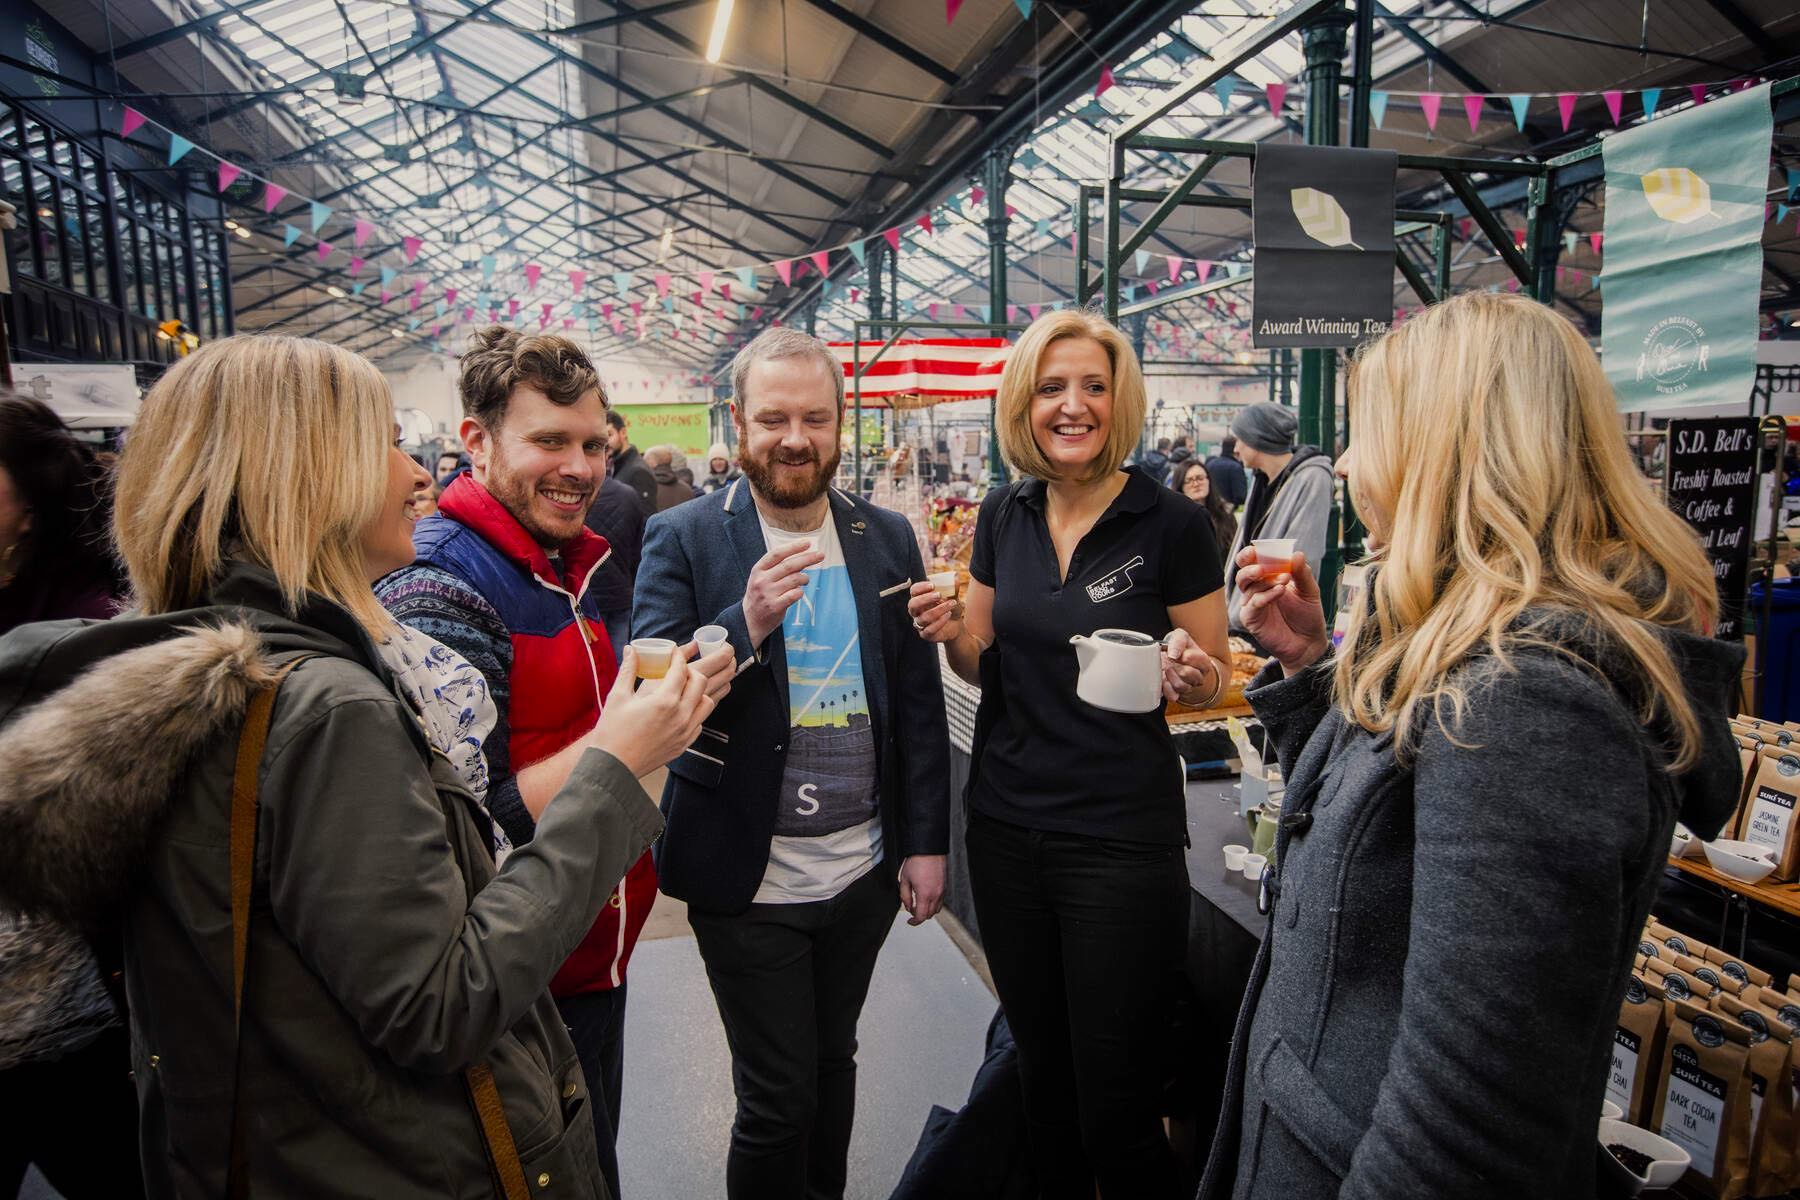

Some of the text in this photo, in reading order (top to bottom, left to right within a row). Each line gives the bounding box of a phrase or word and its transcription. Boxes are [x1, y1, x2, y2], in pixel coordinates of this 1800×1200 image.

[1259, 317, 1386, 339] Award Winning Tea
[1675, 428, 1753, 455] S.D. Bell's
[1672, 466, 1752, 491] Freshly Roasted
[1686, 497, 1734, 522] Coffee &
[1717, 526, 1744, 549] Leaf
[1090, 576, 1117, 593] BELFAST
[795, 783, 820, 816] S
[1777, 797, 1792, 807] TEA
[1758, 810, 1780, 825] JASMINE
[1752, 820, 1780, 838] GREEN TEA
[1620, 1035, 1636, 1049] TEA
[1672, 1048, 1697, 1066] taste
[1613, 1072, 1628, 1089] CHAI
[1701, 1080, 1721, 1096] TEA
[1670, 1089, 1715, 1124] DARK COCOA
[1683, 1113, 1697, 1132] TEA
